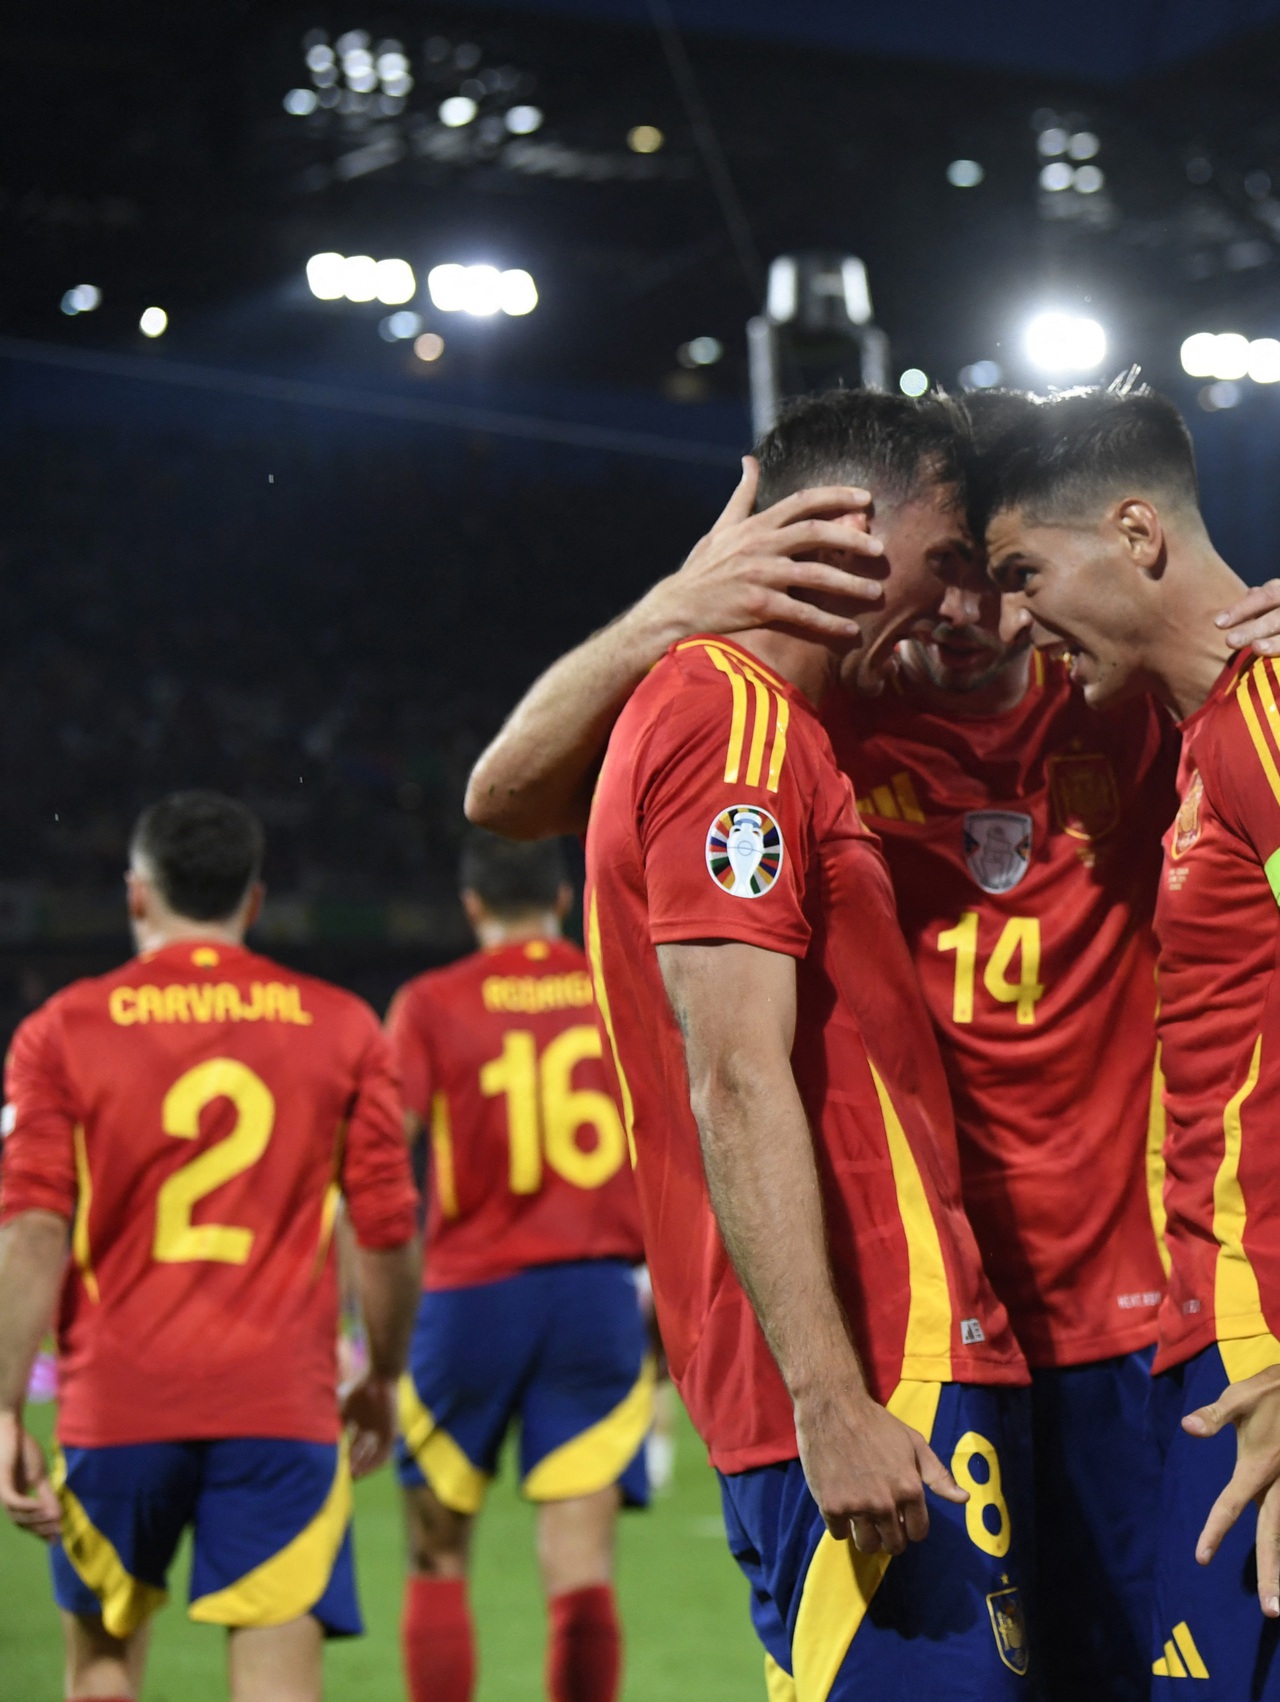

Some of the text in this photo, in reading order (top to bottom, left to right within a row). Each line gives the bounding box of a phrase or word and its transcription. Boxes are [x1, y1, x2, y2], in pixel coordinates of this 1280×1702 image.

[109, 981, 314, 1026] CARVAJAL
[937, 912, 1045, 1025] 14
[153, 1057, 275, 1264] 2
[479, 1024, 627, 1196] 16
[951, 1430, 1011, 1558] 8
